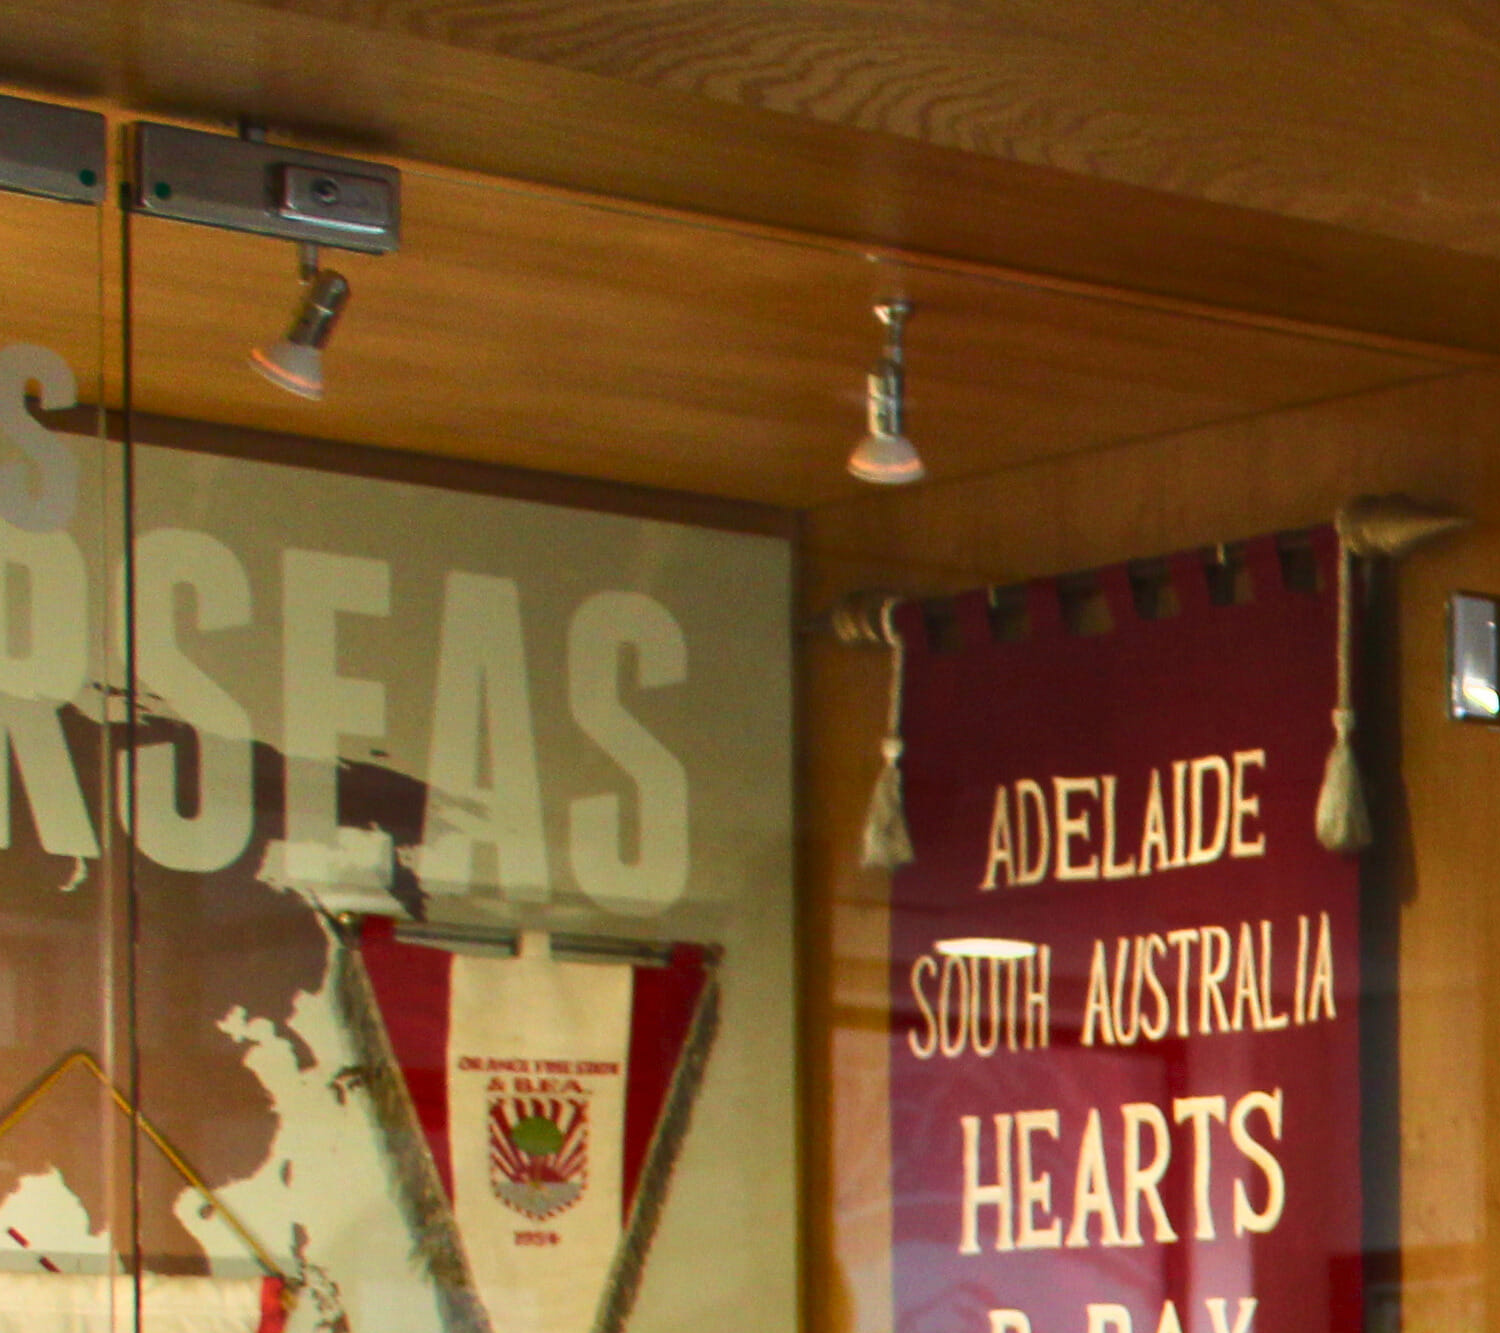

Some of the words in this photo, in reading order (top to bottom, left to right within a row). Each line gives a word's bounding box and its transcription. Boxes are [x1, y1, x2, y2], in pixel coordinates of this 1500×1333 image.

[979, 749, 1265, 891] ADELAIDE
[908, 943, 1050, 1060] SOUTH
[1080, 912, 1336, 1047] AUSTRALIA
[959, 1087, 1285, 1254] HEARTS
